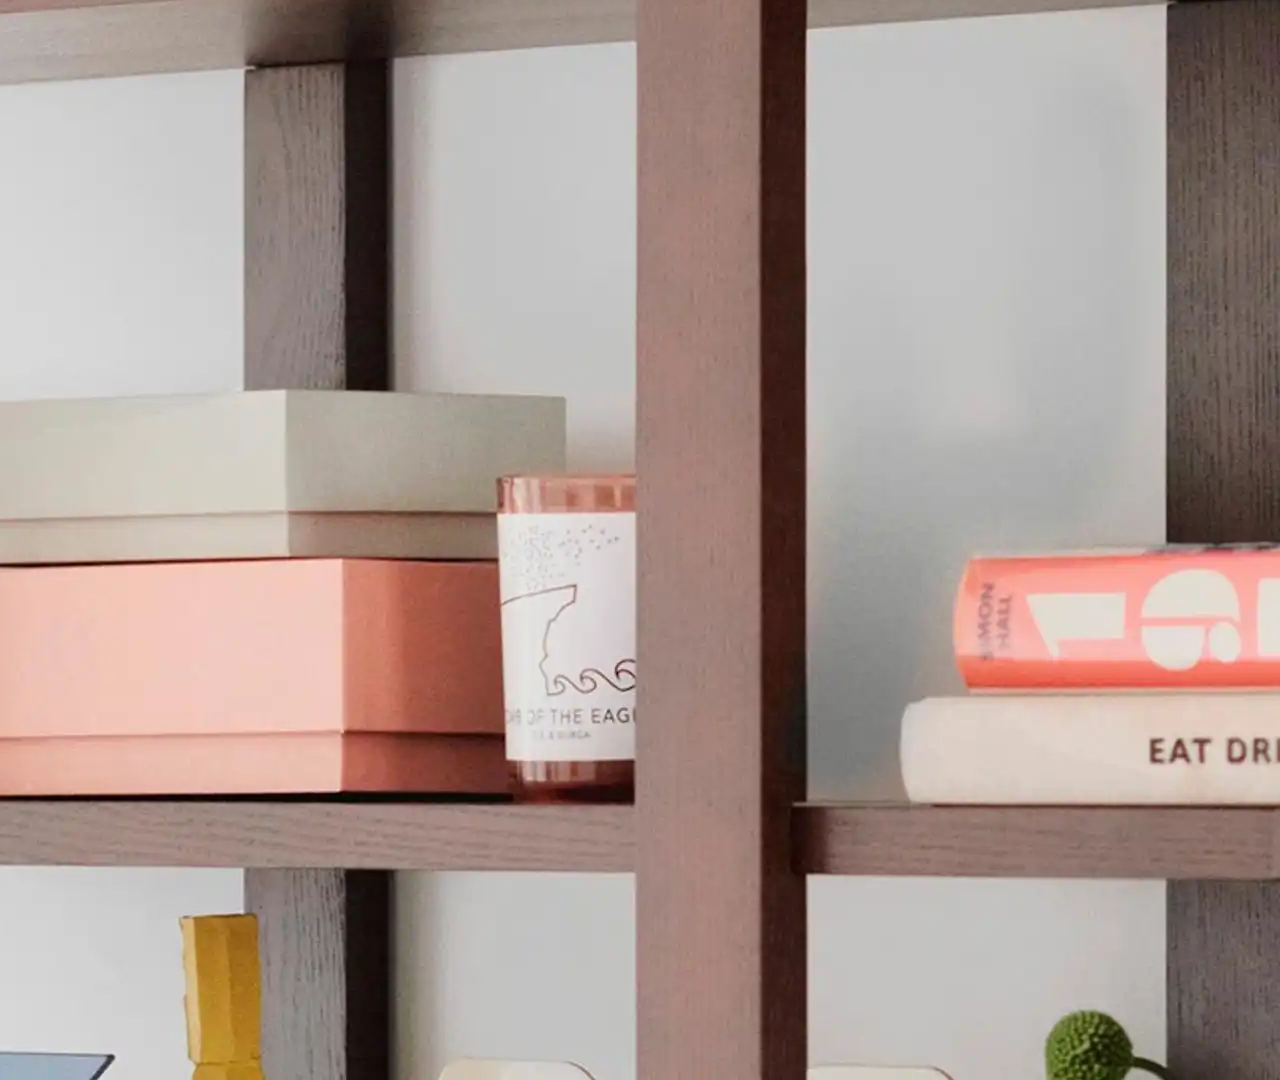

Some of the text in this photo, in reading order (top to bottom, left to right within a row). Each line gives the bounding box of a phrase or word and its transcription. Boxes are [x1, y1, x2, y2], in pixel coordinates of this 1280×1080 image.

[996, 594, 1012, 651] HALL
[550, 707, 584, 724] THE
[1148, 737, 1212, 764] EAT
